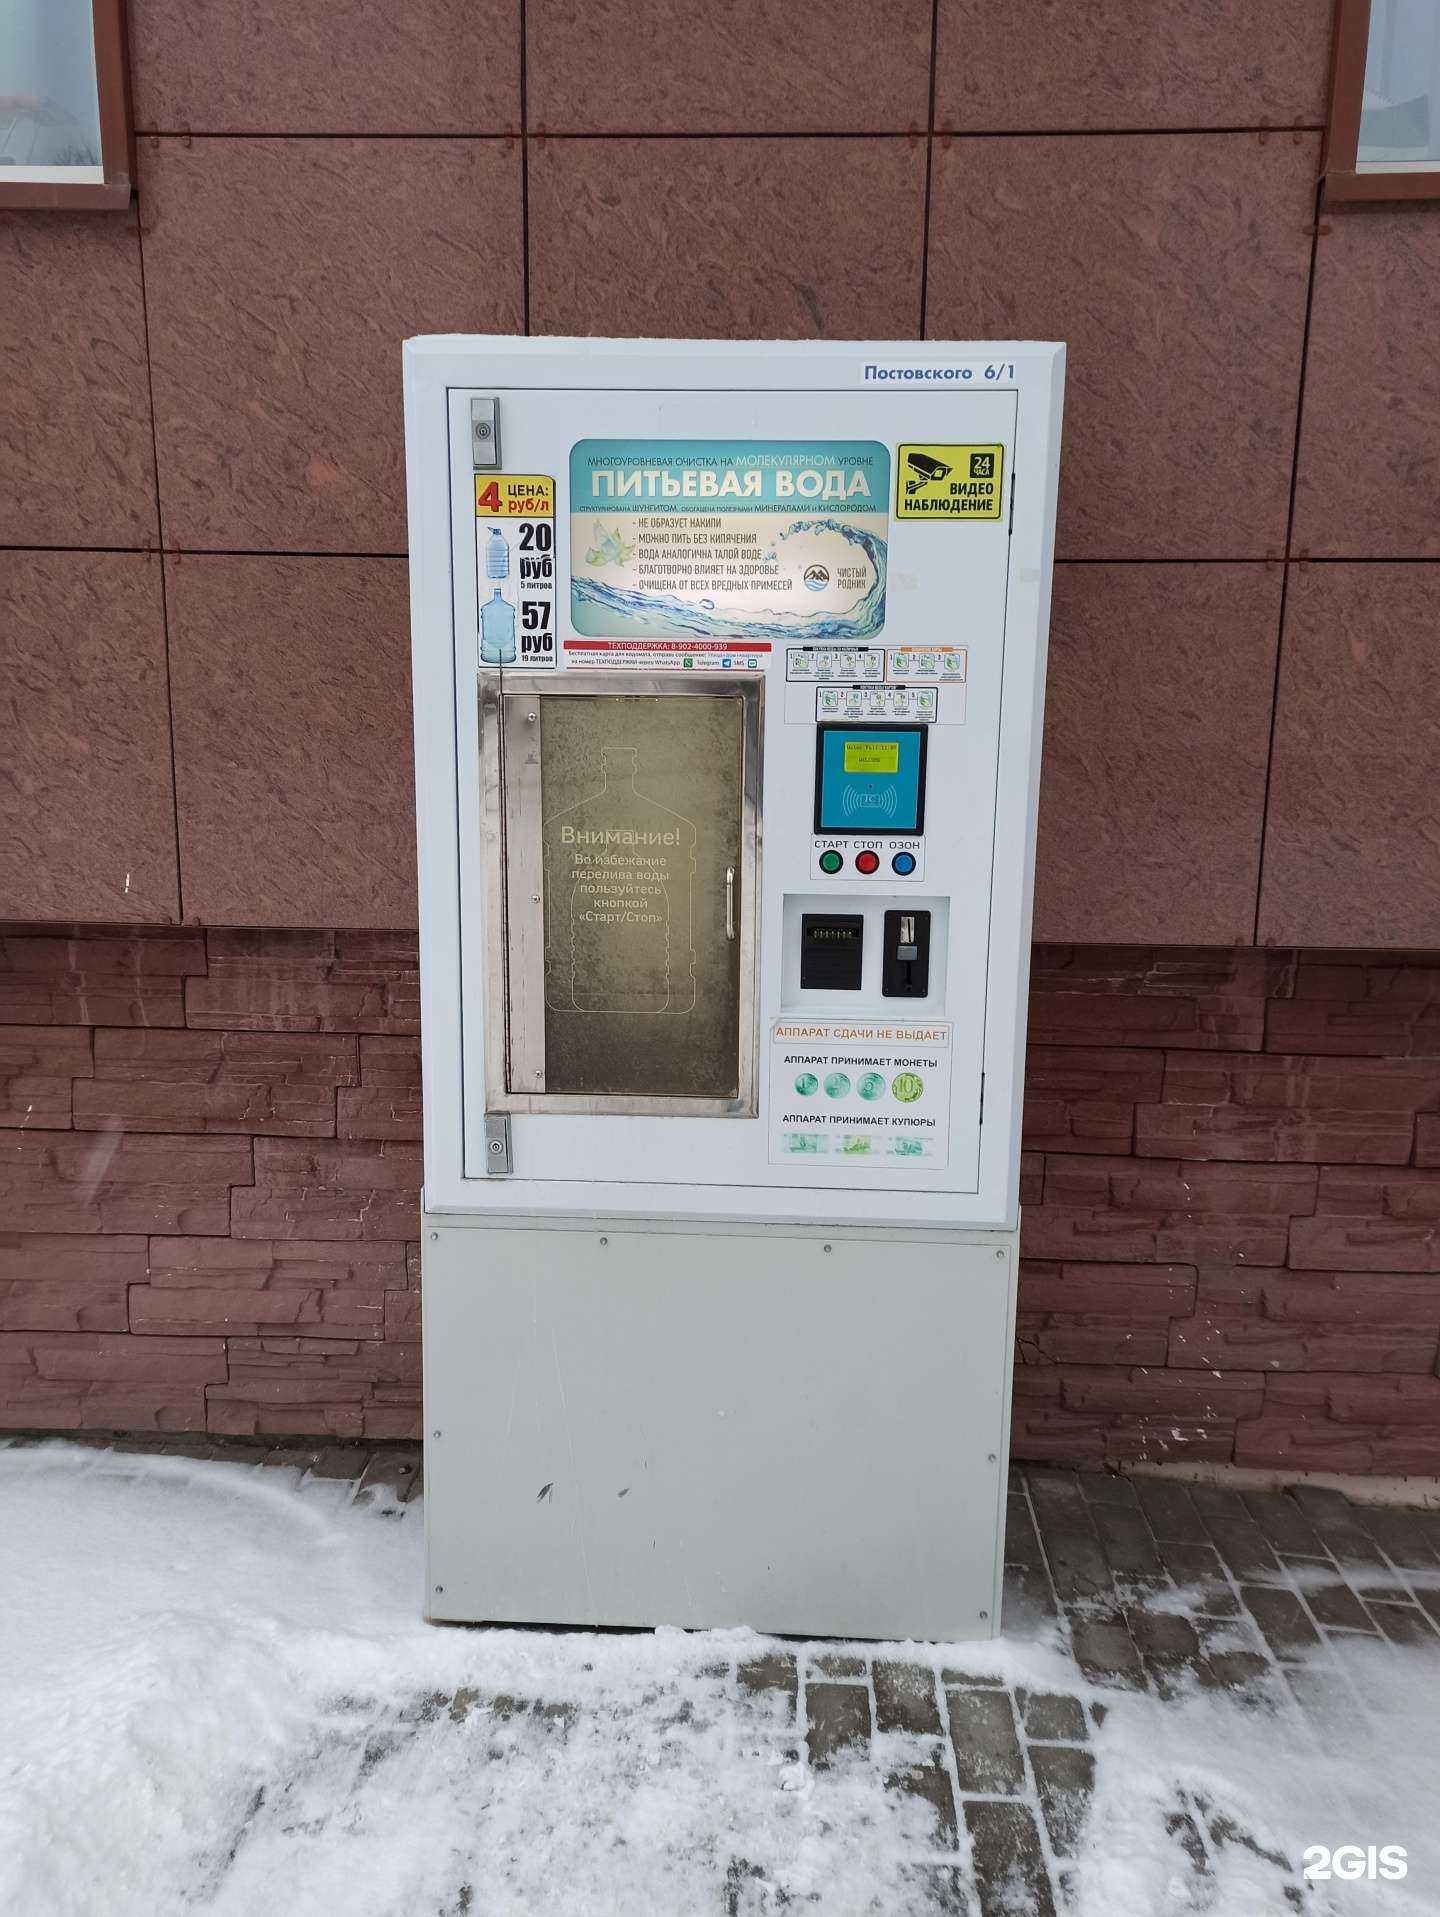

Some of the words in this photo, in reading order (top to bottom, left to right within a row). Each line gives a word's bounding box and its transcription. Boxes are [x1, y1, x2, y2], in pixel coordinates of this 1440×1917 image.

[864, 365, 973, 380] Постовского
[984, 363, 1014, 381] 6/1
[587, 457, 673, 467] МНОГОУРОВНЕВАЯ
[675, 457, 718, 467] ОЧИСТКА
[720, 457, 733, 466] НА
[736, 454, 836, 467] МОЛЕКУЛЯРНОМ
[837, 456, 873, 466] УРОВНЕ
[974, 456, 991, 469] 24
[973, 468, 990, 476] ЧАСА
[507, 484, 549, 498] ЦЕНА:
[591, 470, 762, 498] ПИТЬЕВАЯ
[775, 469, 872, 501] ВОДА
[949, 483, 994, 497] ВИДЕО
[477, 481, 503, 513] 4
[507, 498, 550, 513] руб/л
[754, 504, 811, 513] МИНЕРАЛАМИ
[904, 499, 993, 513] НАБЛЮДЕНИЕ
[638, 517, 649, 528] НЕ
[650, 517, 689, 528] ОБРАЗУЕТ
[689, 517, 722, 528] НАКИПИ
[518, 523, 552, 551] 20
[638, 533, 670, 544] МОЖНО
[671, 533, 692, 544] ПИТЬ
[693, 533, 708, 544] БЕЗ
[710, 533, 757, 544] КИПЯЧЕНИЯ
[638, 549, 660, 560] ВОДА
[661, 549, 712, 560] АНАЛОГИЧНА
[714, 547, 739, 560] ТАЛОЙ
[741, 549, 762, 560] ВОДЕ
[519, 554, 553, 580] руб
[638, 564, 693, 575] БЛАГОТВОРНО
[694, 564, 725, 575] ВЛИЯЕТ
[726, 564, 738, 575] НА
[739, 564, 780, 576] ЗДОРОВЬЕ
[837, 566, 867, 578] ЧИСТЫЙ
[520, 581, 525, 589] 5
[526, 581, 553, 590] литров
[638, 580, 677, 591] ОЧИЩЕНА
[678, 579, 689, 590] ОТ
[690, 579, 710, 590] ВСЕХ
[711, 580, 749, 591] ВРЕДНЫХ
[750, 578, 793, 591] ПРИМЕСЕЙ
[837, 579, 866, 589] РОДНИК
[521, 601, 552, 630] 57
[521, 633, 553, 654] руб
[607, 641, 670, 651] ТЕХПОДДЕРЖКА:
[521, 654, 529, 662] 19
[529, 655, 553, 663] литров
[561, 825, 681, 846] Внимание!
[814, 840, 849, 849] СТАРТ
[853, 840, 883, 849] СТОП
[889, 841, 920, 849] ОЗОН
[575, 853, 591, 865] Во
[595, 853, 667, 867] избежание
[571, 869, 633, 882] перелива
[636, 870, 670, 883] воды
[580, 884, 662, 896] пользуйтесь
[593, 898, 648, 909] кнопкой
[579, 910, 663, 924] «Старт/Стоп»
[776, 1027, 830, 1037] АППАРАТ
[833, 1029, 873, 1040] СДАЧИ
[876, 1029, 893, 1039] НЕ
[896, 1030, 947, 1041] ВЫДАЕТ
[783, 1055, 828, 1065] АППАРАТ
[831, 1056, 891, 1066] ПРИНИМАЕТ
[893, 1058, 938, 1068] МОНЕТЫ
[782, 1114, 827, 1124] АППАРАТ
[829, 1115, 889, 1126] ПРИНИМАЕТ
[891, 1117, 936, 1127] КУПЮРЫ
